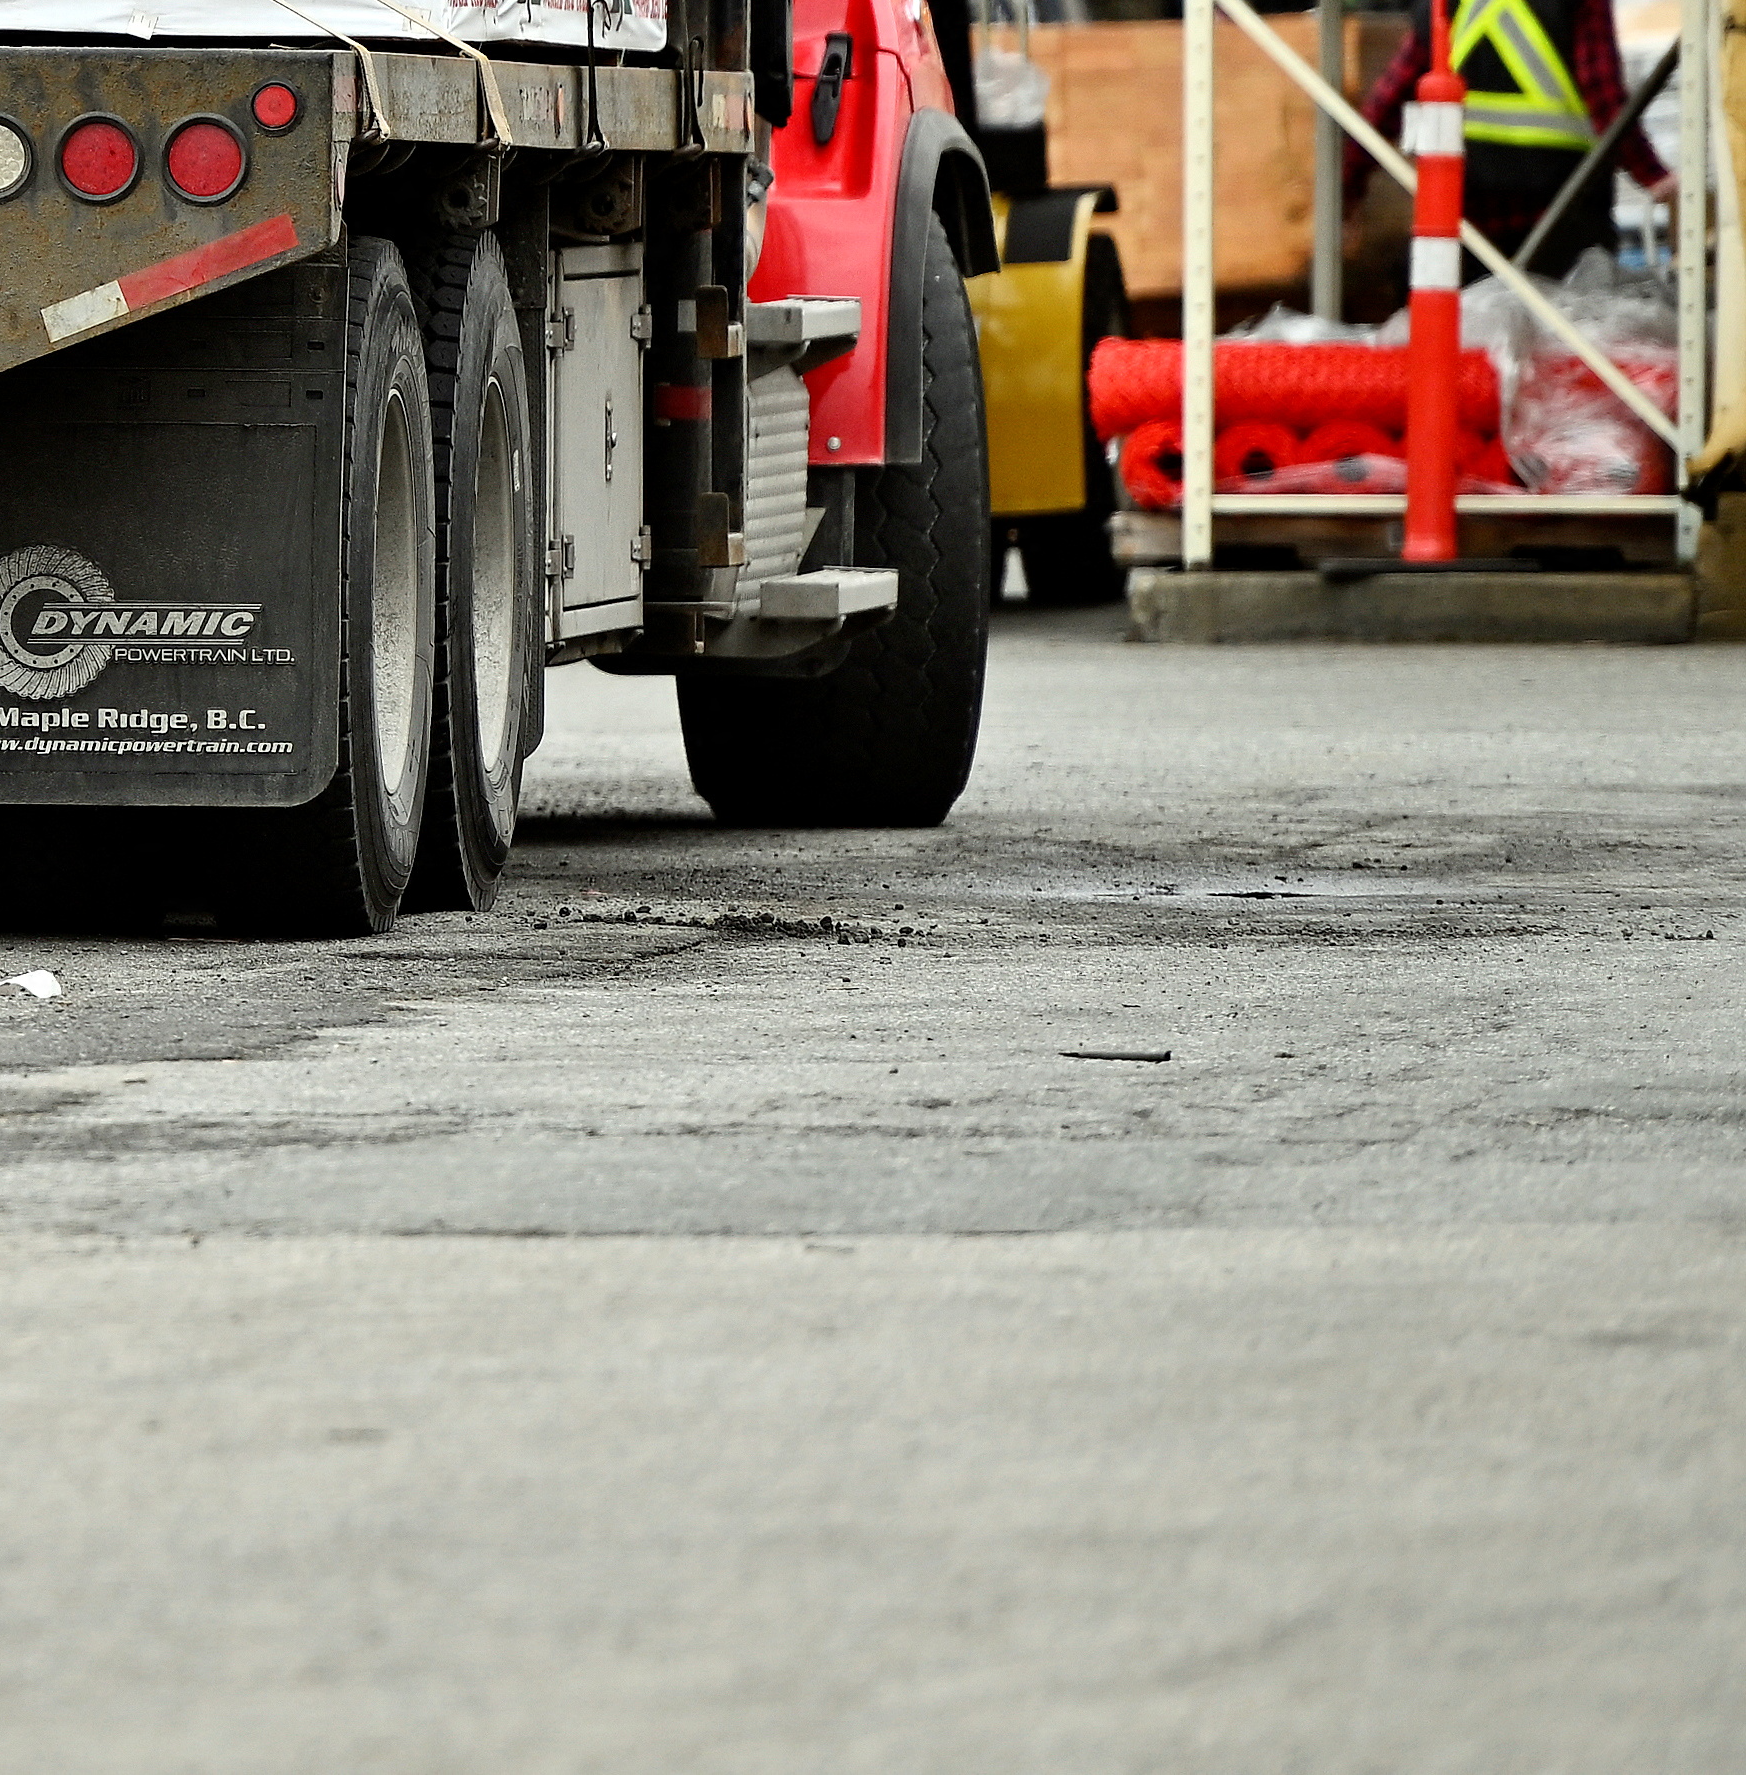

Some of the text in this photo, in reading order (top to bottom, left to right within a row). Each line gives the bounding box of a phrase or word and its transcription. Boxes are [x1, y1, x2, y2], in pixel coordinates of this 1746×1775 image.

[31, 610, 255, 636] DYNAMIC
[115, 648, 295, 663] POWERTRAIN LTD.
[98, 708, 198, 734] Ridge,
[207, 709, 267, 730] B.C.
